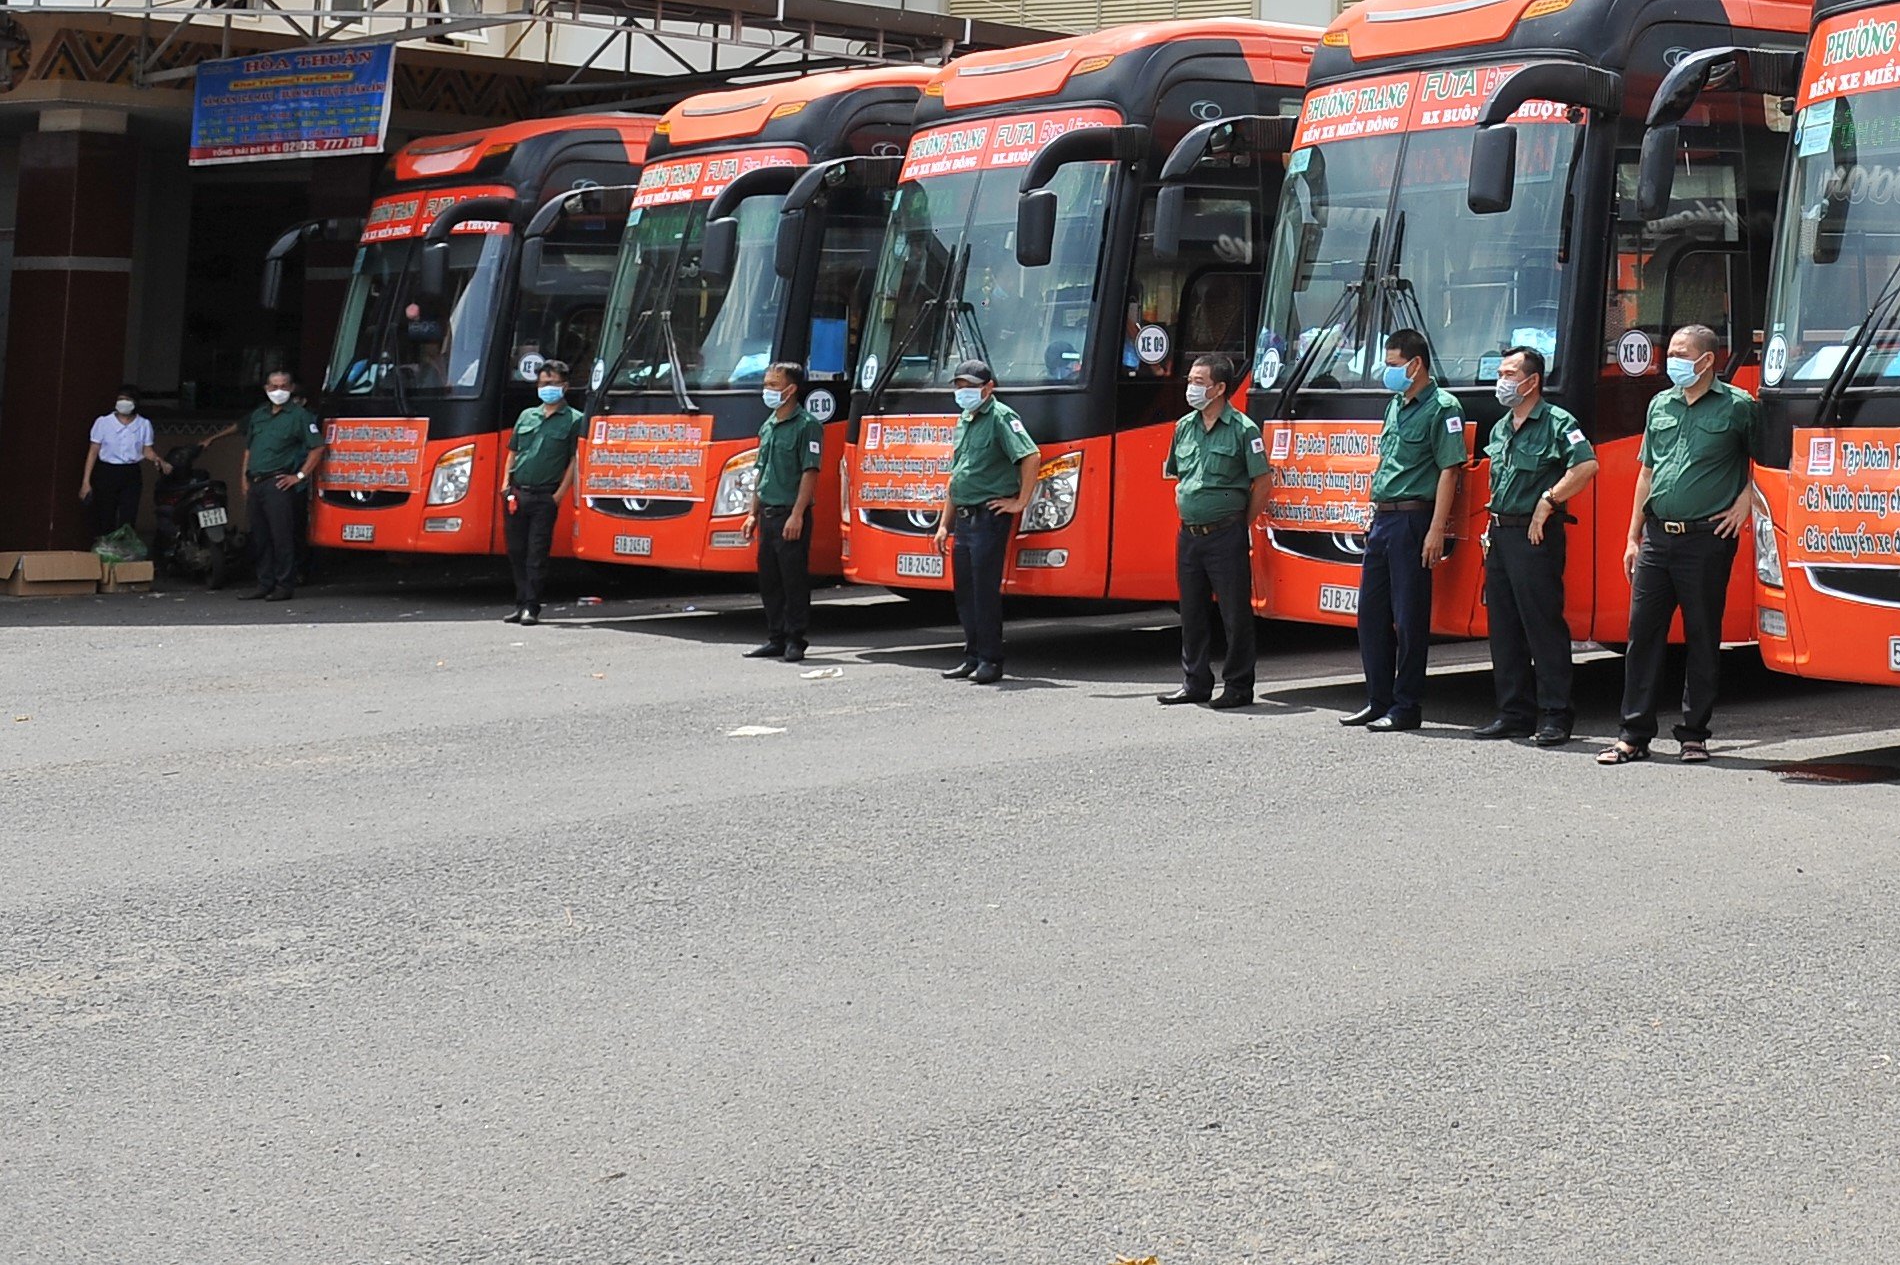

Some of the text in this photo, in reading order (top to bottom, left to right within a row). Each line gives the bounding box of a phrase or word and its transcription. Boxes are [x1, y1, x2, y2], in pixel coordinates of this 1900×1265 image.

[1823, 18, 1897, 66] PHƯƠNG
[1357, 81, 1409, 113] TRANG
[1421, 69, 1476, 102] FUTA
[1808, 71, 1837, 99] BẾN
[1838, 72, 1861, 91] XE
[1510, 100, 1568, 120] HUỘT
[993, 122, 1036, 149] FUTA
[1141, 336, 1152, 352] XE
[1623, 343, 1648, 363] XE 08
[810, 399, 820, 413] XE
[1328, 429, 1369, 455] PHƯƠNG
[1841, 441, 1861, 476] Tập
[1863, 441, 1890, 470] Đoàn
[1806, 482, 1820, 511] Cả
[1822, 485, 1854, 512] Nước
[1856, 485, 1887, 519] cùng
[1805, 525, 1827, 553] Các
[1829, 522, 1876, 559] chuyến
[1876, 535, 1892, 554] xe
